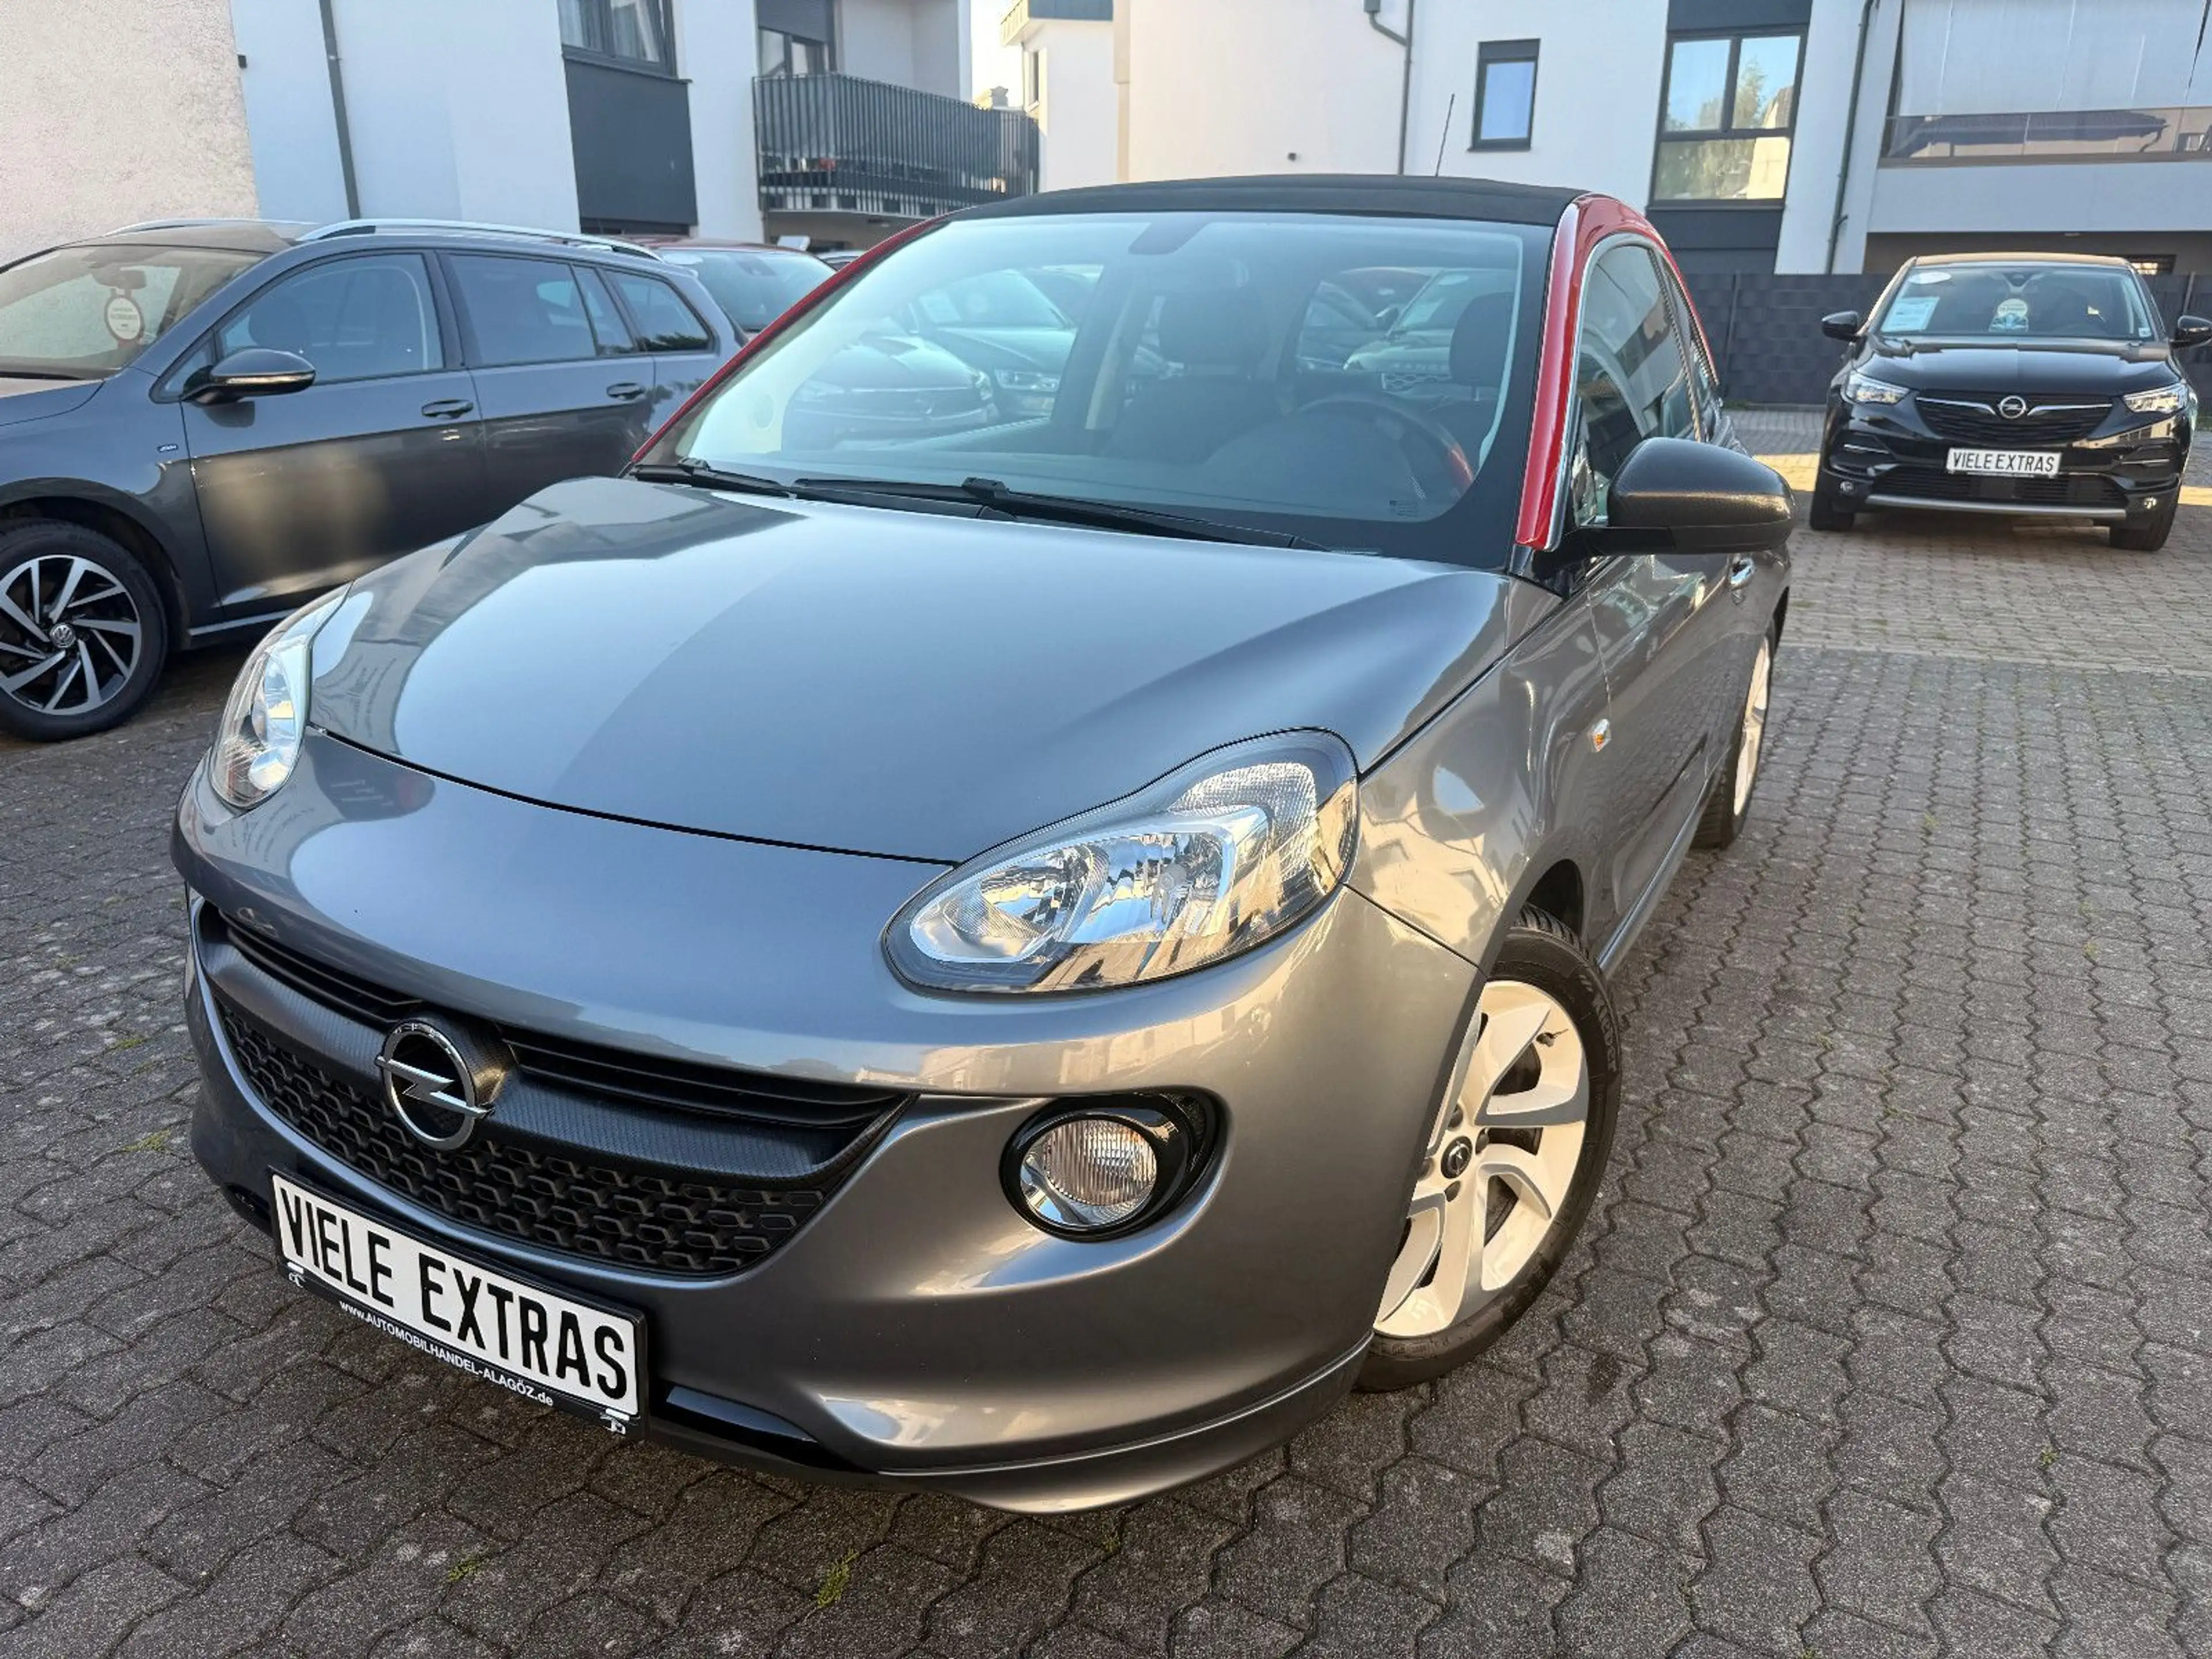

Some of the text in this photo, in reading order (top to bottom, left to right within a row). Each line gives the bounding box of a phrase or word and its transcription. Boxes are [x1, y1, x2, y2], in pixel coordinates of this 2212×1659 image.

[1953, 452, 2055, 472] VIELE EXTRAS
[280, 1187, 628, 1400] VIELE EXTRAS
[339, 1300, 554, 1407] www.AUTOMOBILHANDEL-ALAGÖZ.de
